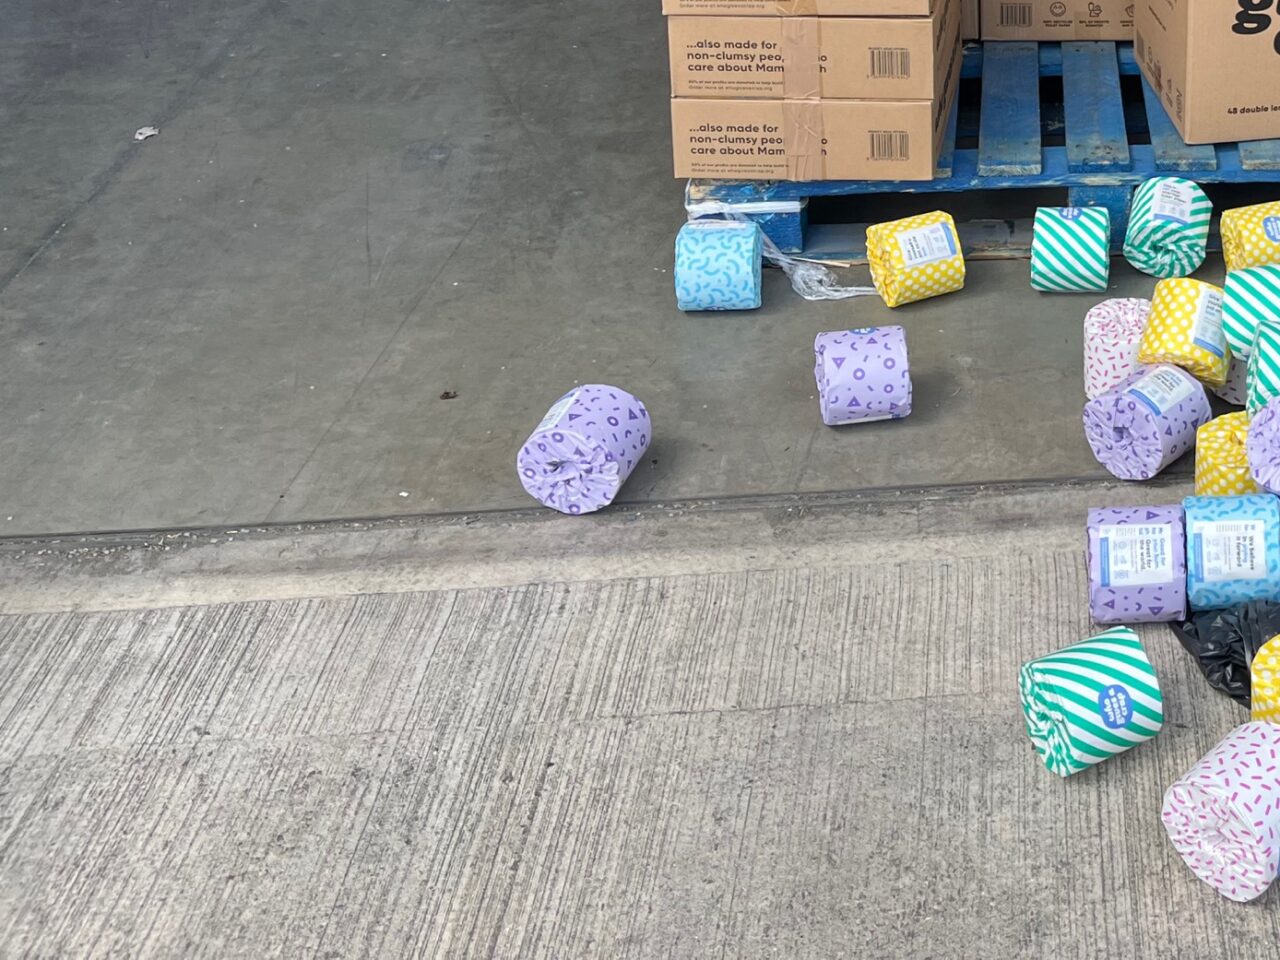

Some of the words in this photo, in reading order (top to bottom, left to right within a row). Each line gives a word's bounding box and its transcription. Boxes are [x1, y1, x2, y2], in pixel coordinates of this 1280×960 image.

[686, 40, 721, 49] ...also
[724, 40, 758, 50] made
[761, 40, 777, 50] for
[687, 51, 755, 62] non-clumsy
[688, 63, 714, 72] care
[717, 63, 752, 72] about
[756, 64, 785, 72] Mam
[1239, 105, 1268, 114] double
[689, 123, 723, 133] ...also
[726, 123, 760, 133] made
[762, 124, 779, 133] for
[689, 135, 757, 145] non-clumsy
[690, 146, 716, 155] care
[719, 146, 754, 156] about
[757, 147, 785, 156] Mam
